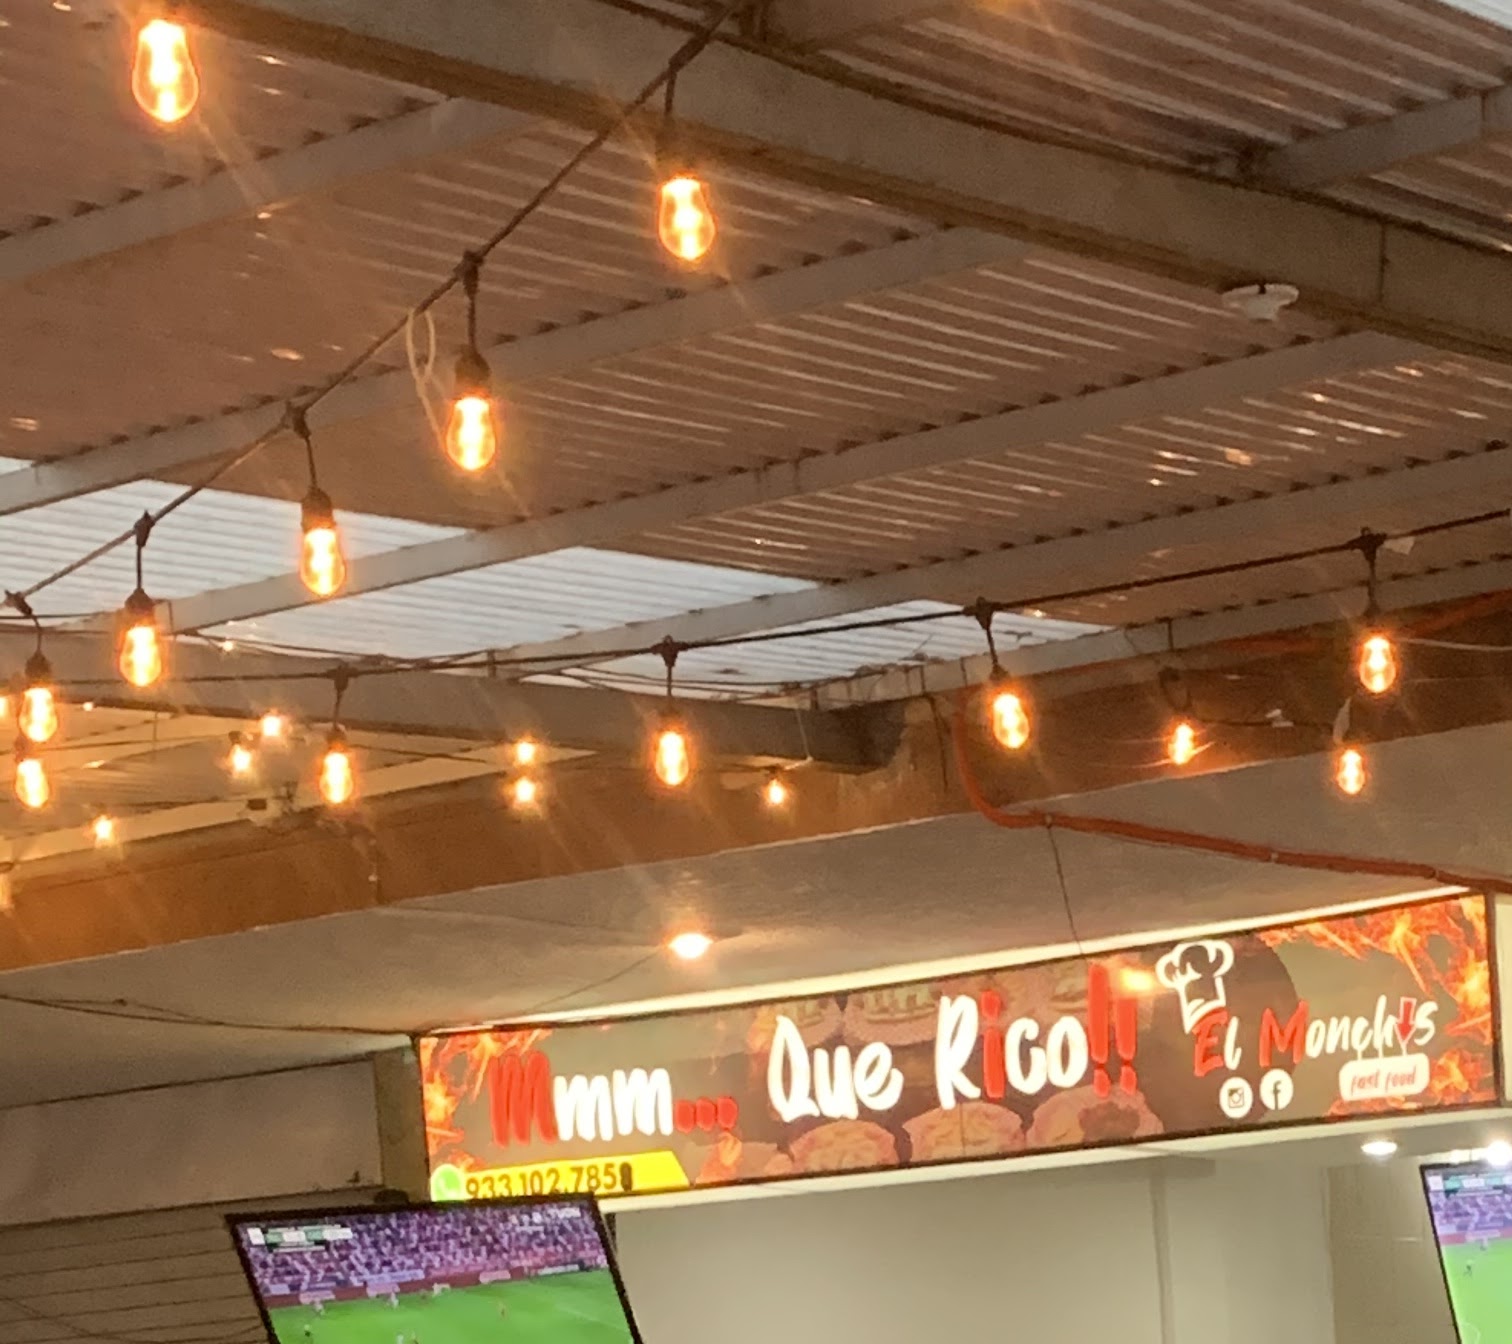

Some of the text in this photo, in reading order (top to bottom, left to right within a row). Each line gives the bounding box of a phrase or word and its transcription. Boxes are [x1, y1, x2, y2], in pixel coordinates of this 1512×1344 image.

[767, 1014, 904, 1123] Que
[1193, 1006, 1242, 1078] El
[1350, 1065, 1418, 1095] fast food
